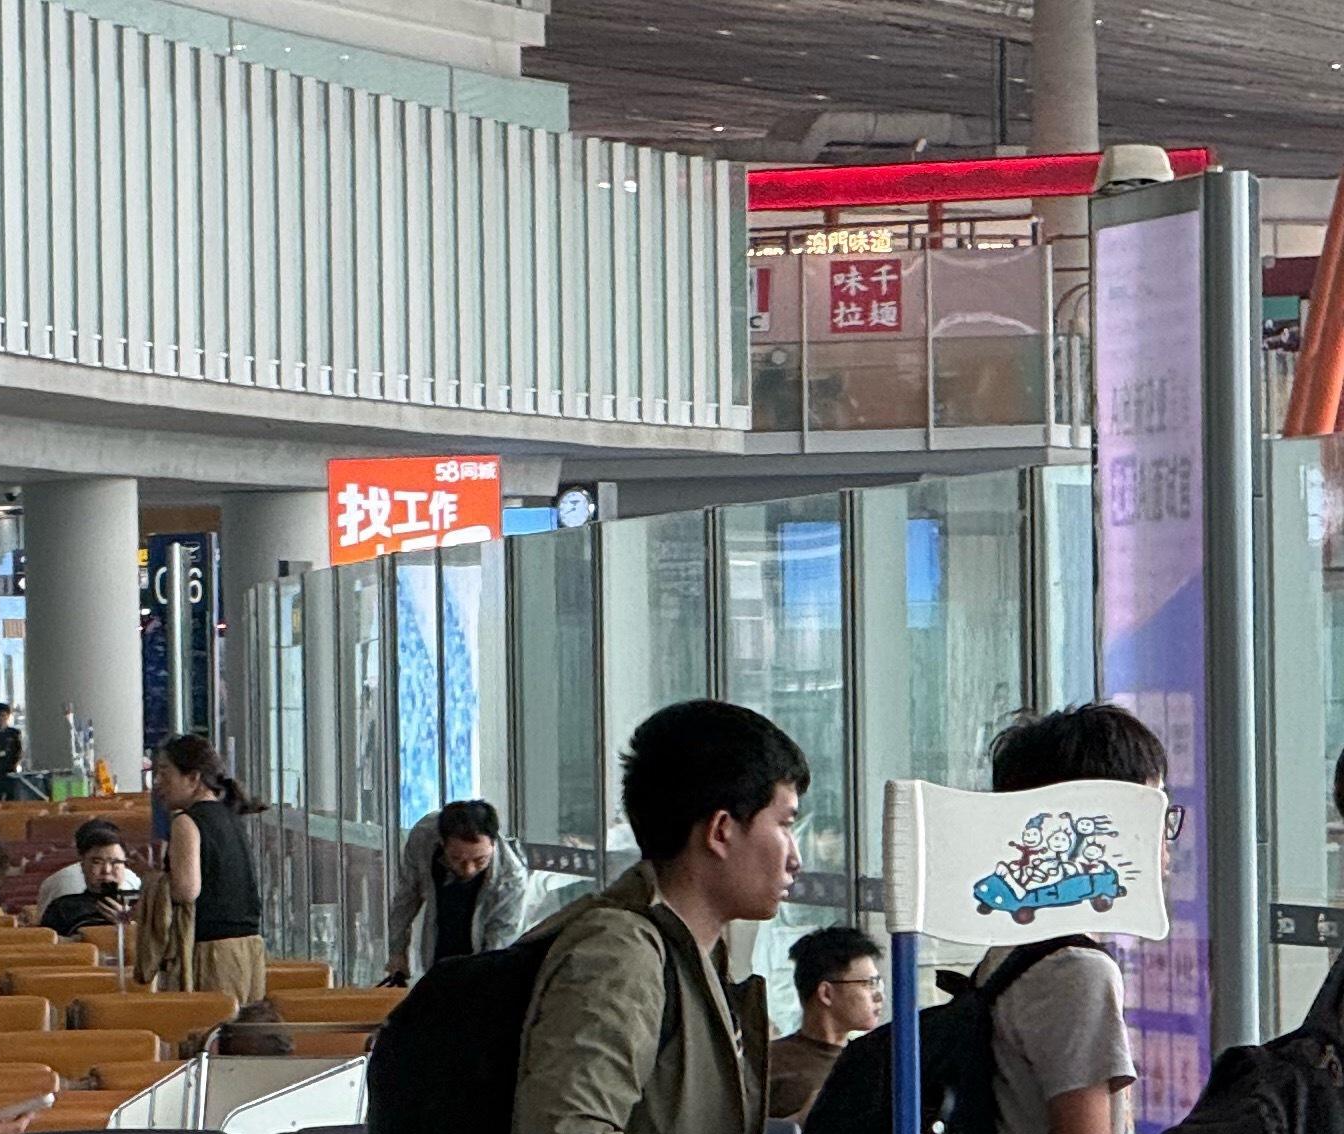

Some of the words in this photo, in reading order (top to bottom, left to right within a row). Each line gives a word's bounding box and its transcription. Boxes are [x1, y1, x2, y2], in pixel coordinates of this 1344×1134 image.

[832, 264, 899, 295] 味千
[435, 459, 498, 482] 58同城
[337, 483, 459, 548] 找工作
